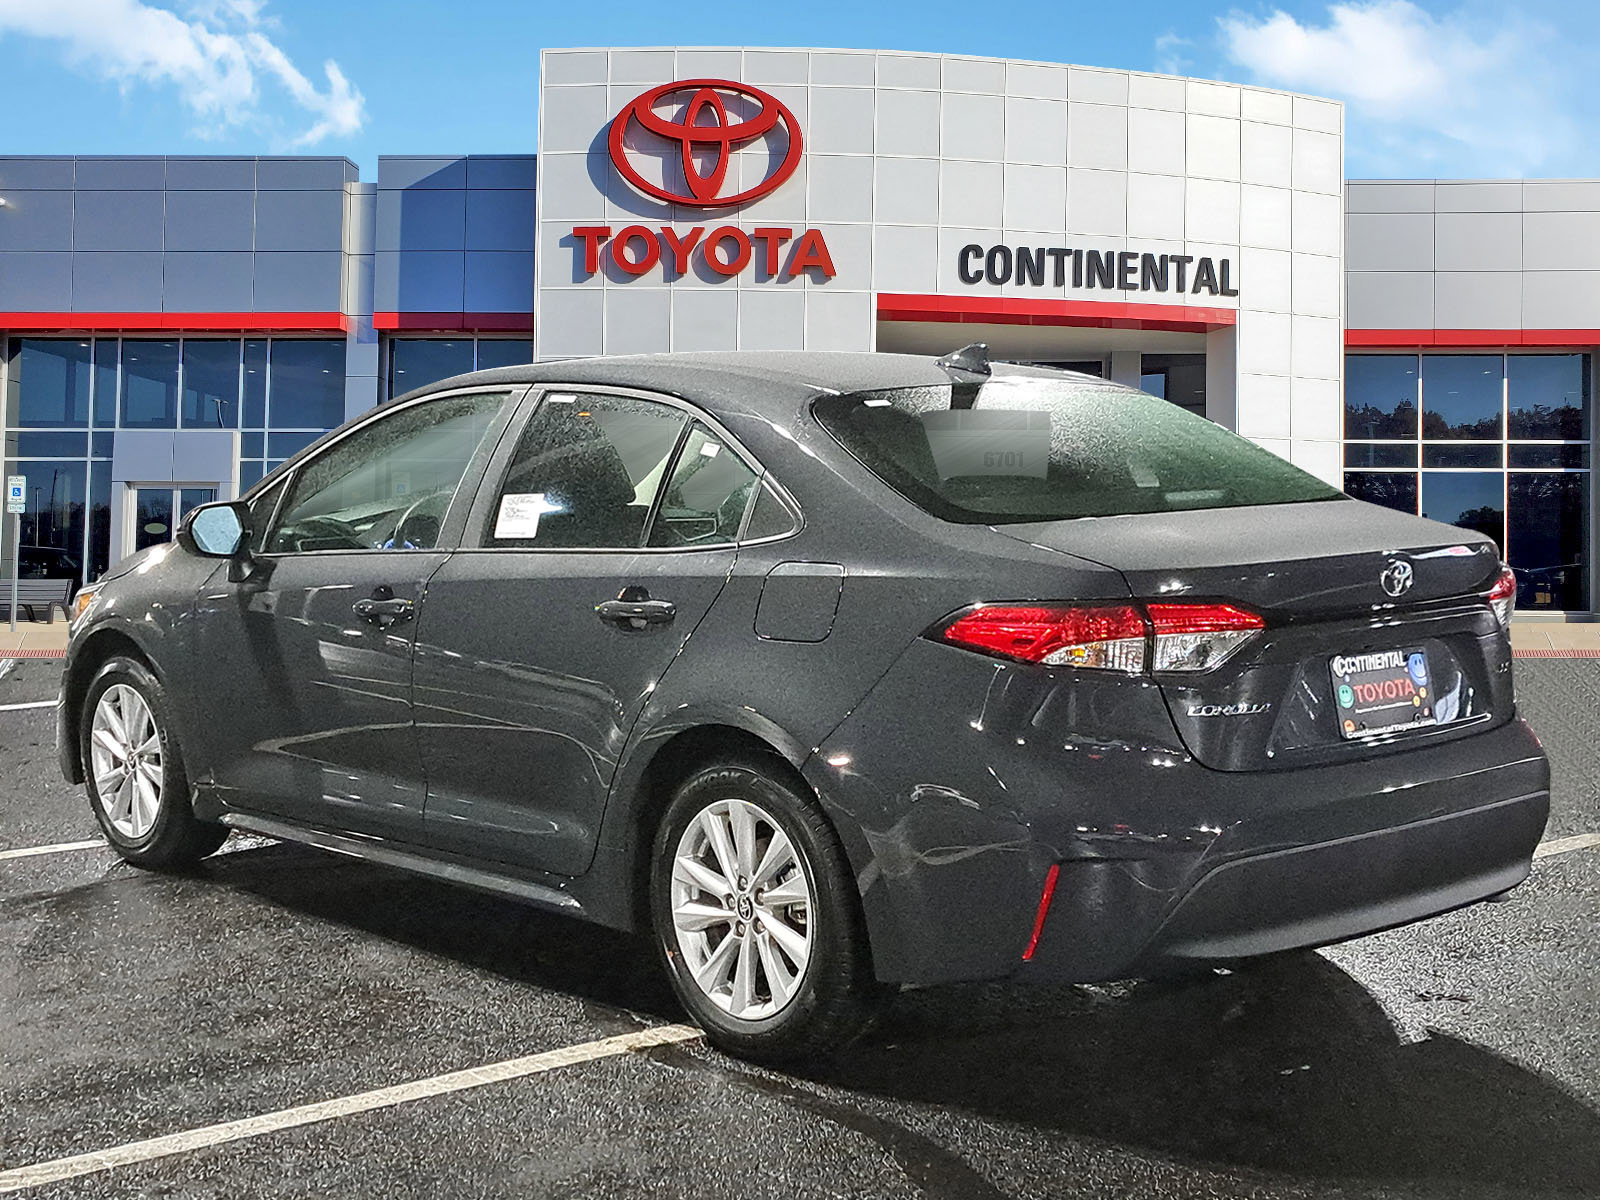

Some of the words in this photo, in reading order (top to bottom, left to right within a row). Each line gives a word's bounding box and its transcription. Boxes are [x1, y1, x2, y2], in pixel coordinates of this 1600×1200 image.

[573, 226, 837, 278] TOYOTA
[959, 243, 1240, 297] CONTINENTAL
[983, 451, 1025, 468] 6701
[1333, 651, 1407, 677] CONTINENTAL
[1353, 678, 1416, 703] TOYOTA
